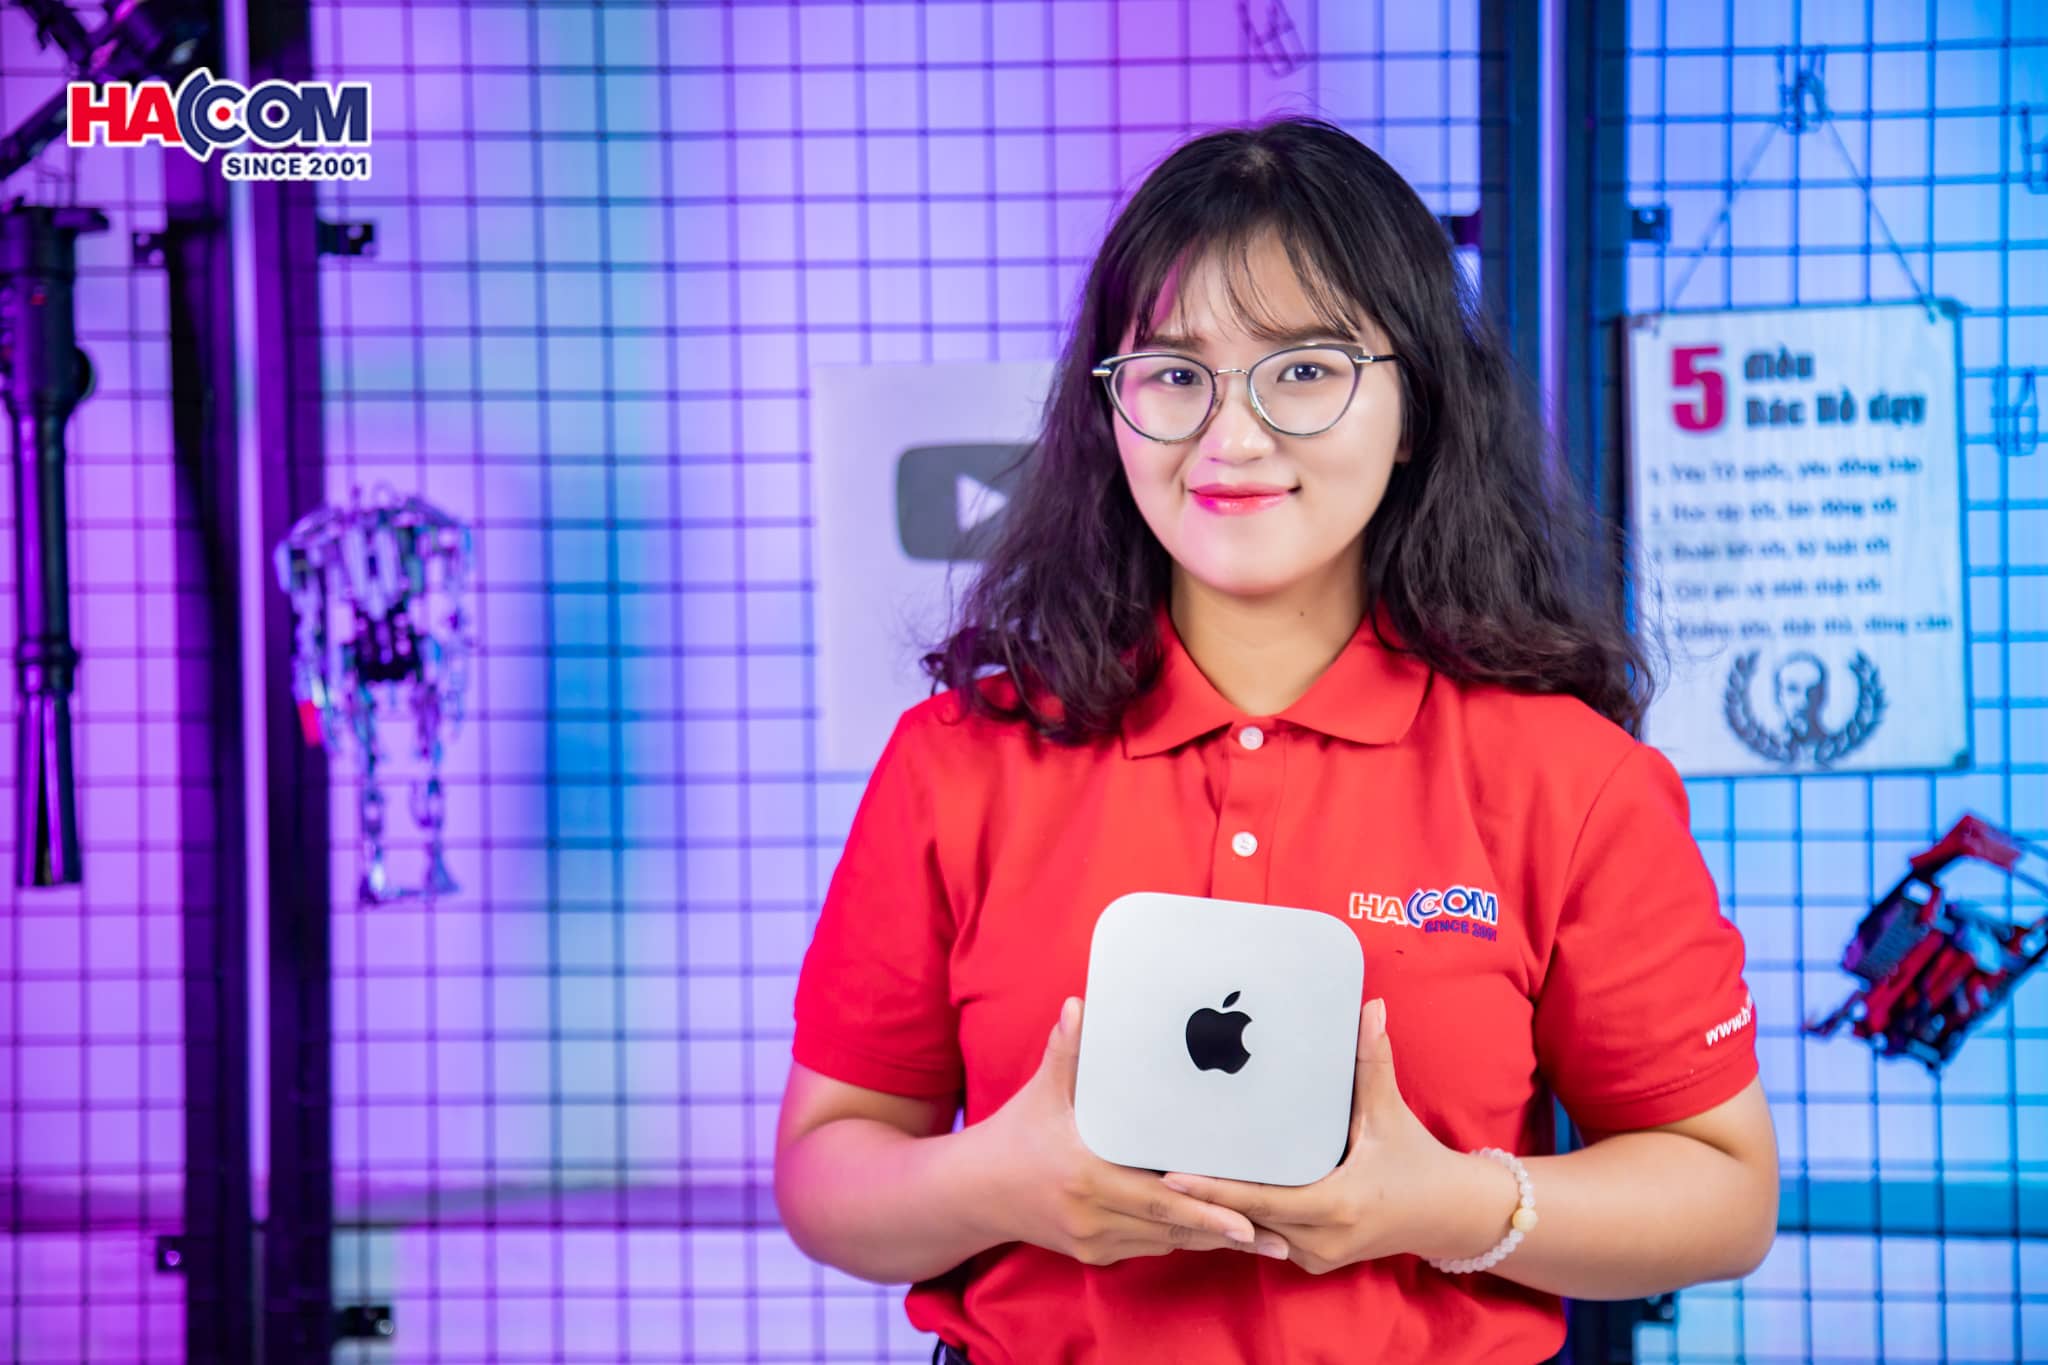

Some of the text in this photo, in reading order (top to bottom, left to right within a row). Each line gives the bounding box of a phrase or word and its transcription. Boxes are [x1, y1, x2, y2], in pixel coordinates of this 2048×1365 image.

[1670, 346, 1727, 433] 5
[1349, 884, 1499, 928] HACOM
[1425, 919, 1497, 942] SINCE 2001
